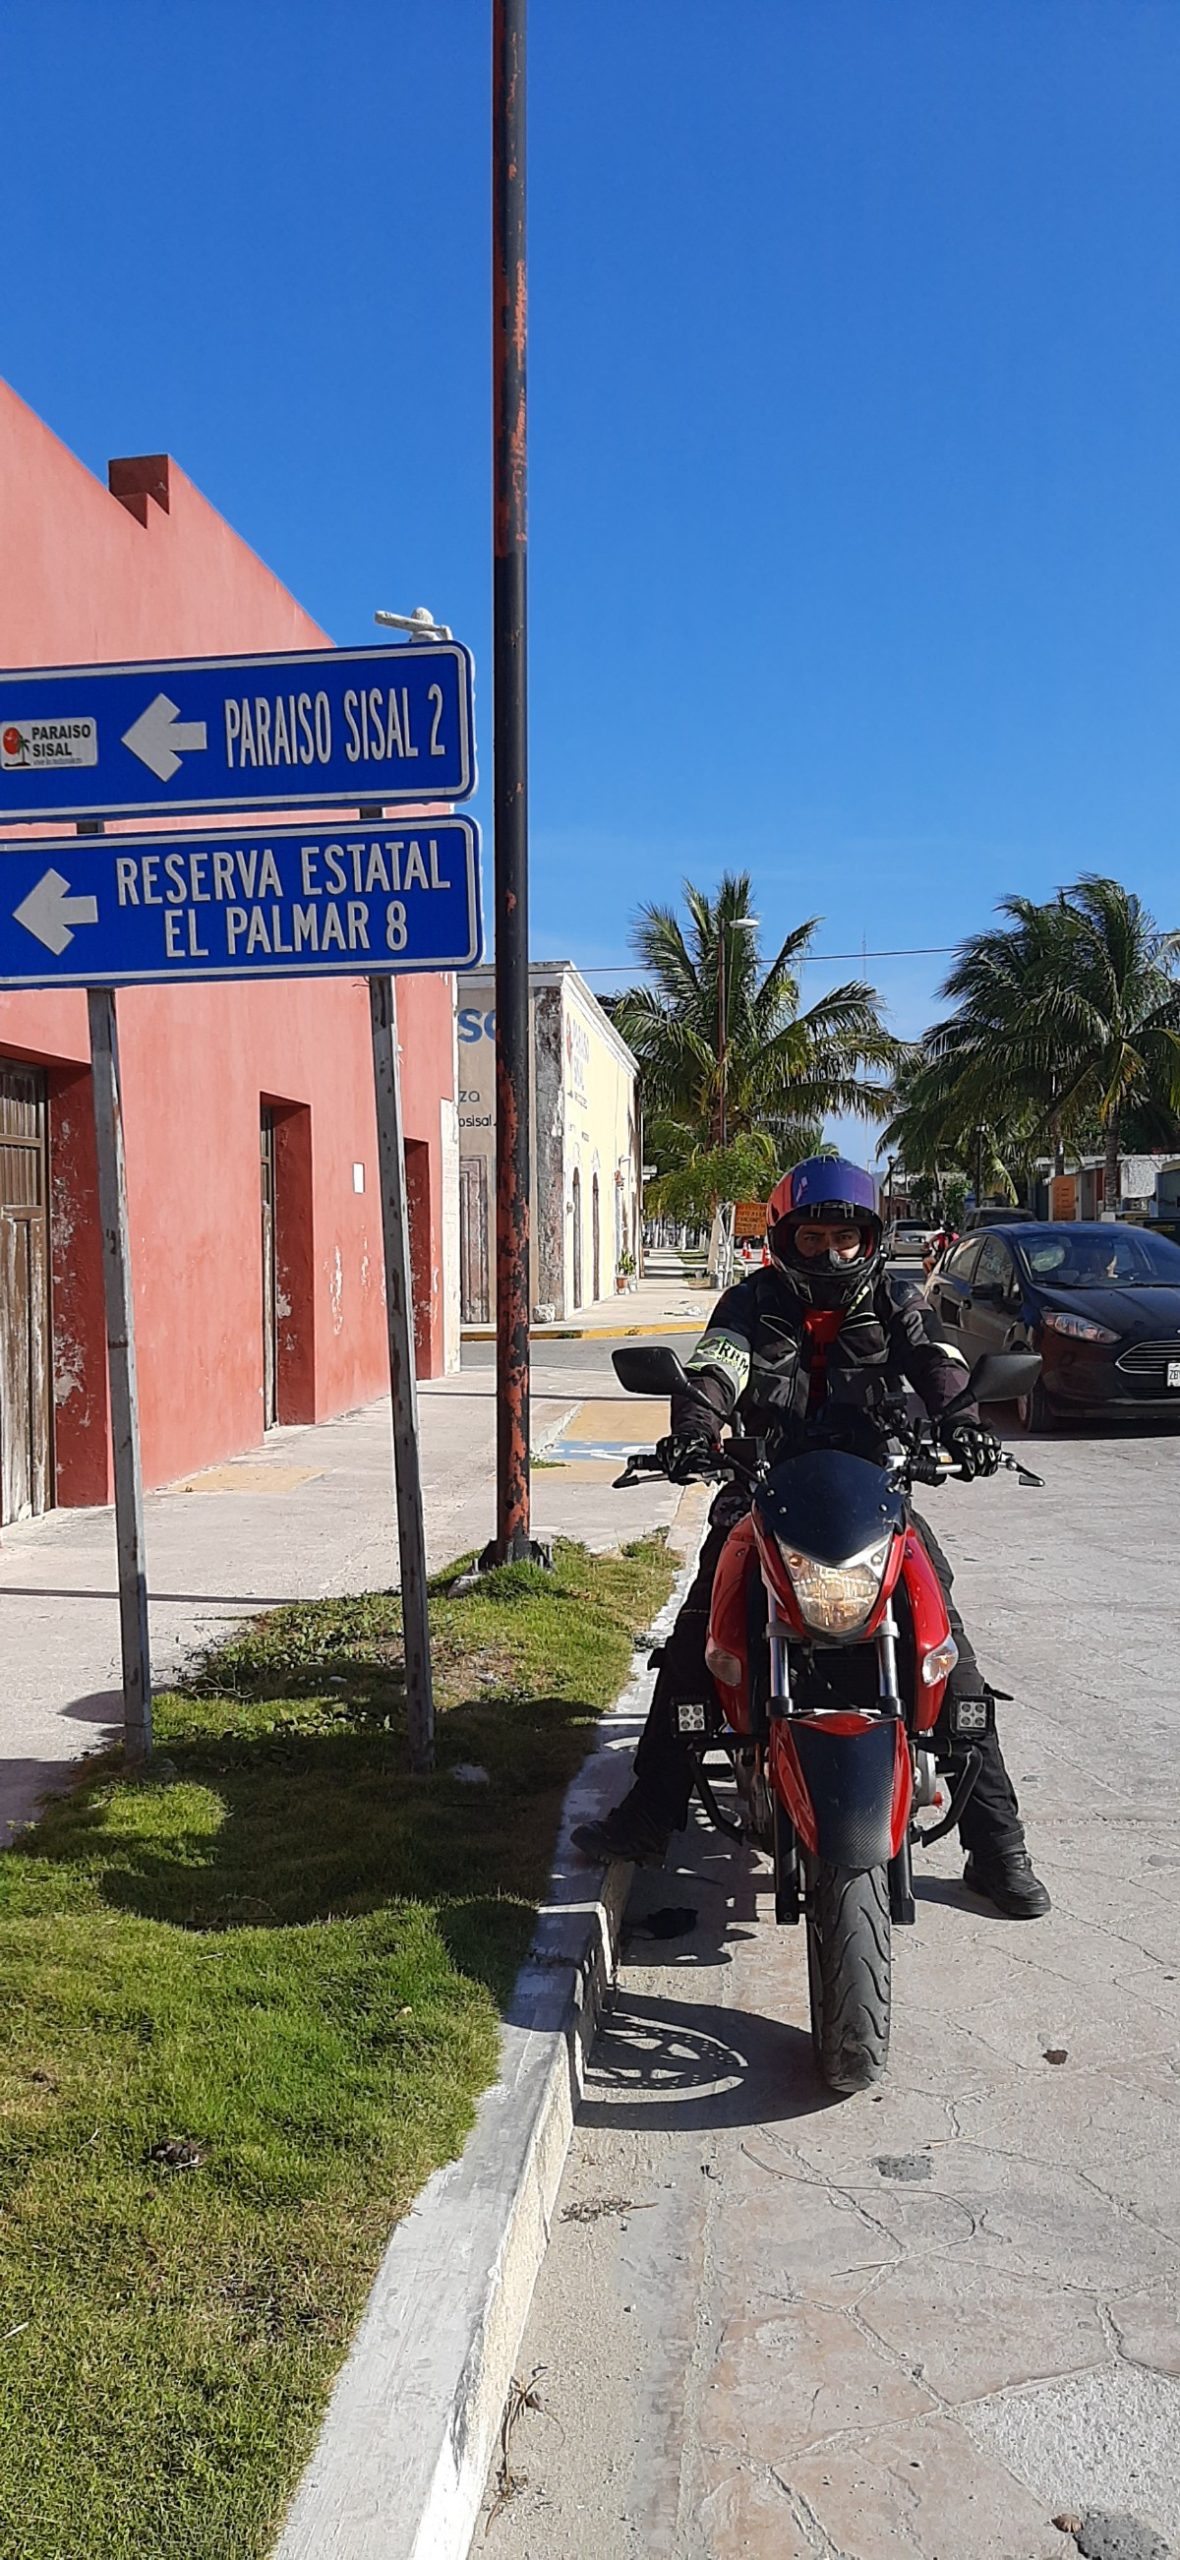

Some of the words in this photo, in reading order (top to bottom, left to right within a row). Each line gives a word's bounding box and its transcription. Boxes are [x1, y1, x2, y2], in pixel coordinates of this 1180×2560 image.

[32, 724, 91, 740] PARAISO
[33, 742, 72, 757] SISAL
[224, 690, 331, 768] PARAISO
[344, 687, 418, 762] SISAL
[428, 683, 445, 755] 2
[116, 849, 283, 906] RESERVA
[301, 840, 450, 895] ESTATAL
[165, 909, 209, 957] EL
[226, 901, 370, 955] PALMAR
[386, 900, 408, 951] 8
